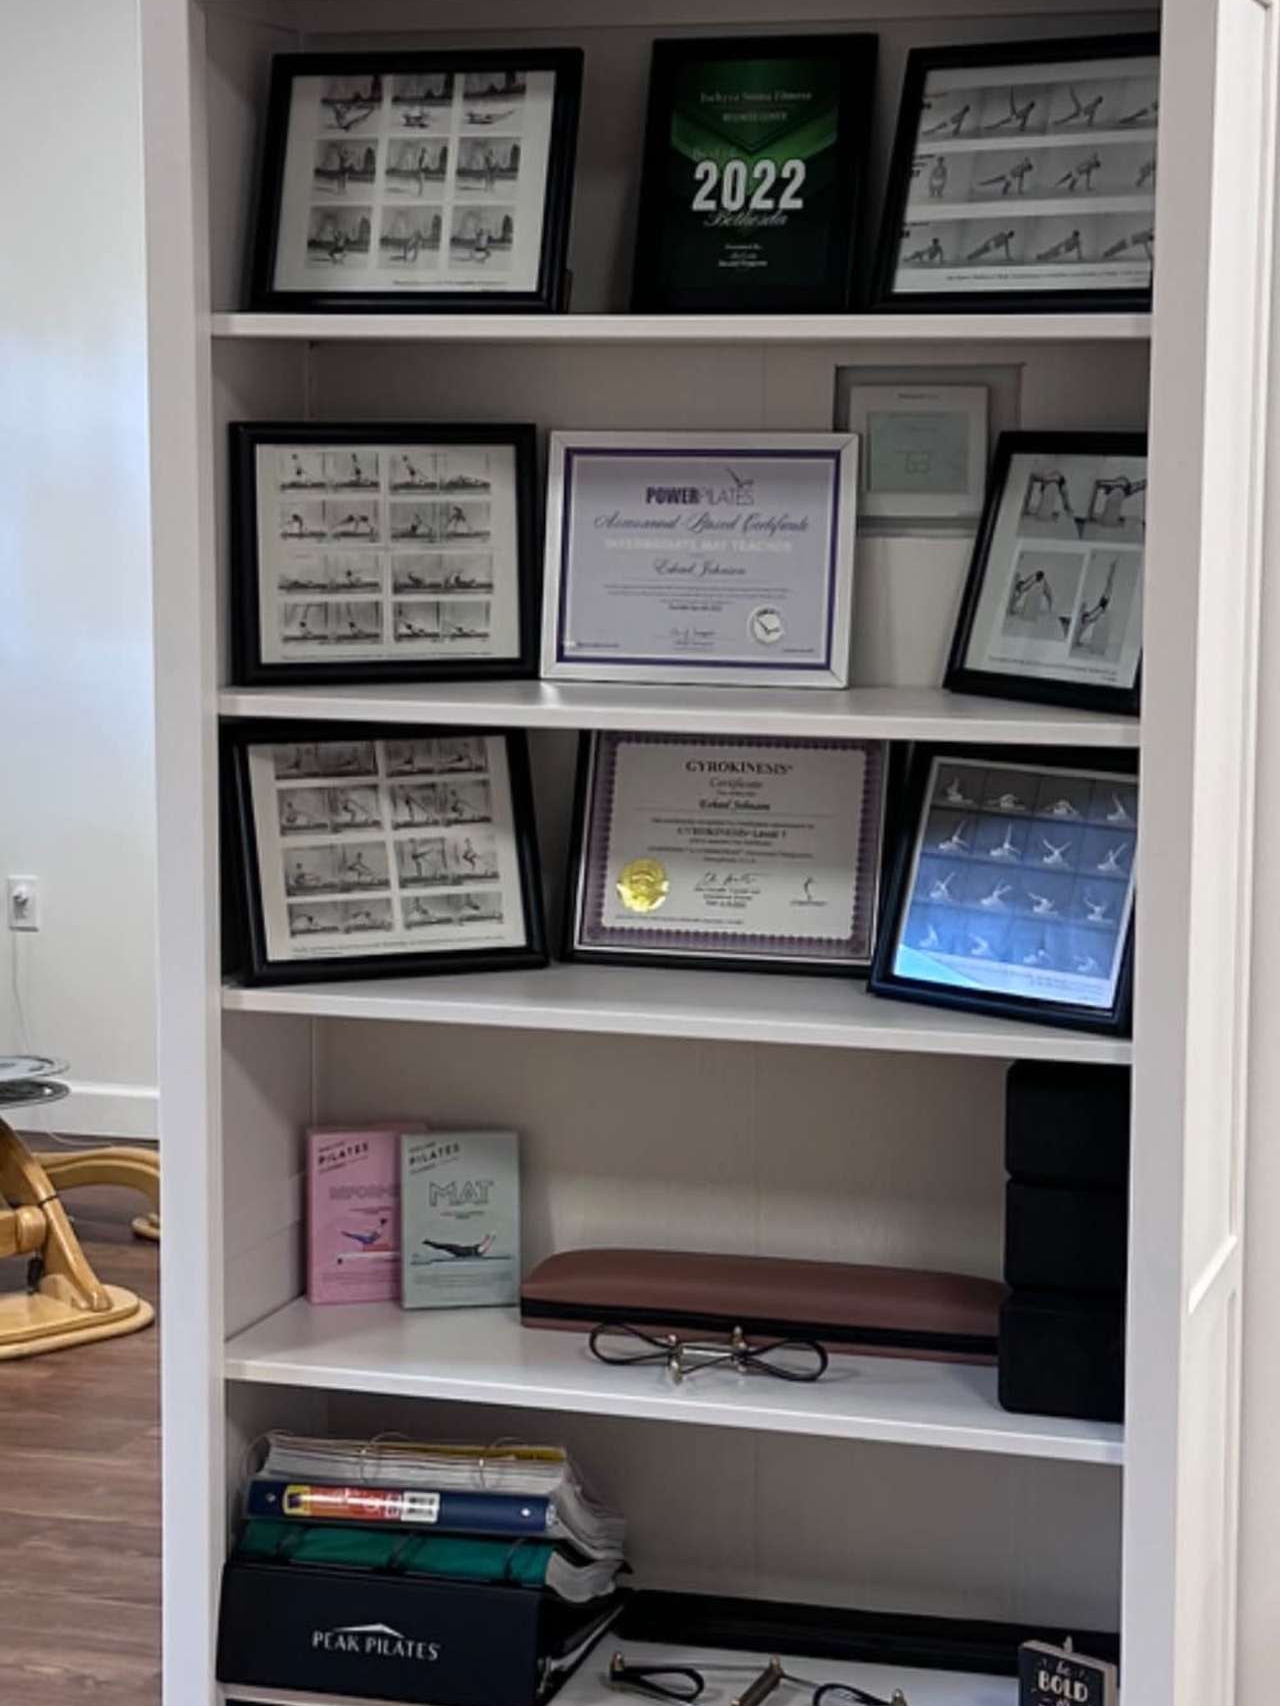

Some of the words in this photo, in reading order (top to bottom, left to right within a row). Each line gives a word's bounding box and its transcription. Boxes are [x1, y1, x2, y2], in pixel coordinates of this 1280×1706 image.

[691, 158, 806, 212] 2022
[703, 209, 788, 227] Bethesda
[743, 513, 809, 536] Certificate
[685, 760, 788, 775] GYROKINESIS
[318, 1142, 369, 1166] PILATES
[409, 1142, 460, 1166] PILATES
[428, 1180, 494, 1208] MAT
[312, 1630, 360, 1652] PEAK
[365, 1636, 440, 1661] PILATES
[1038, 1670, 1089, 1703] BOLD
